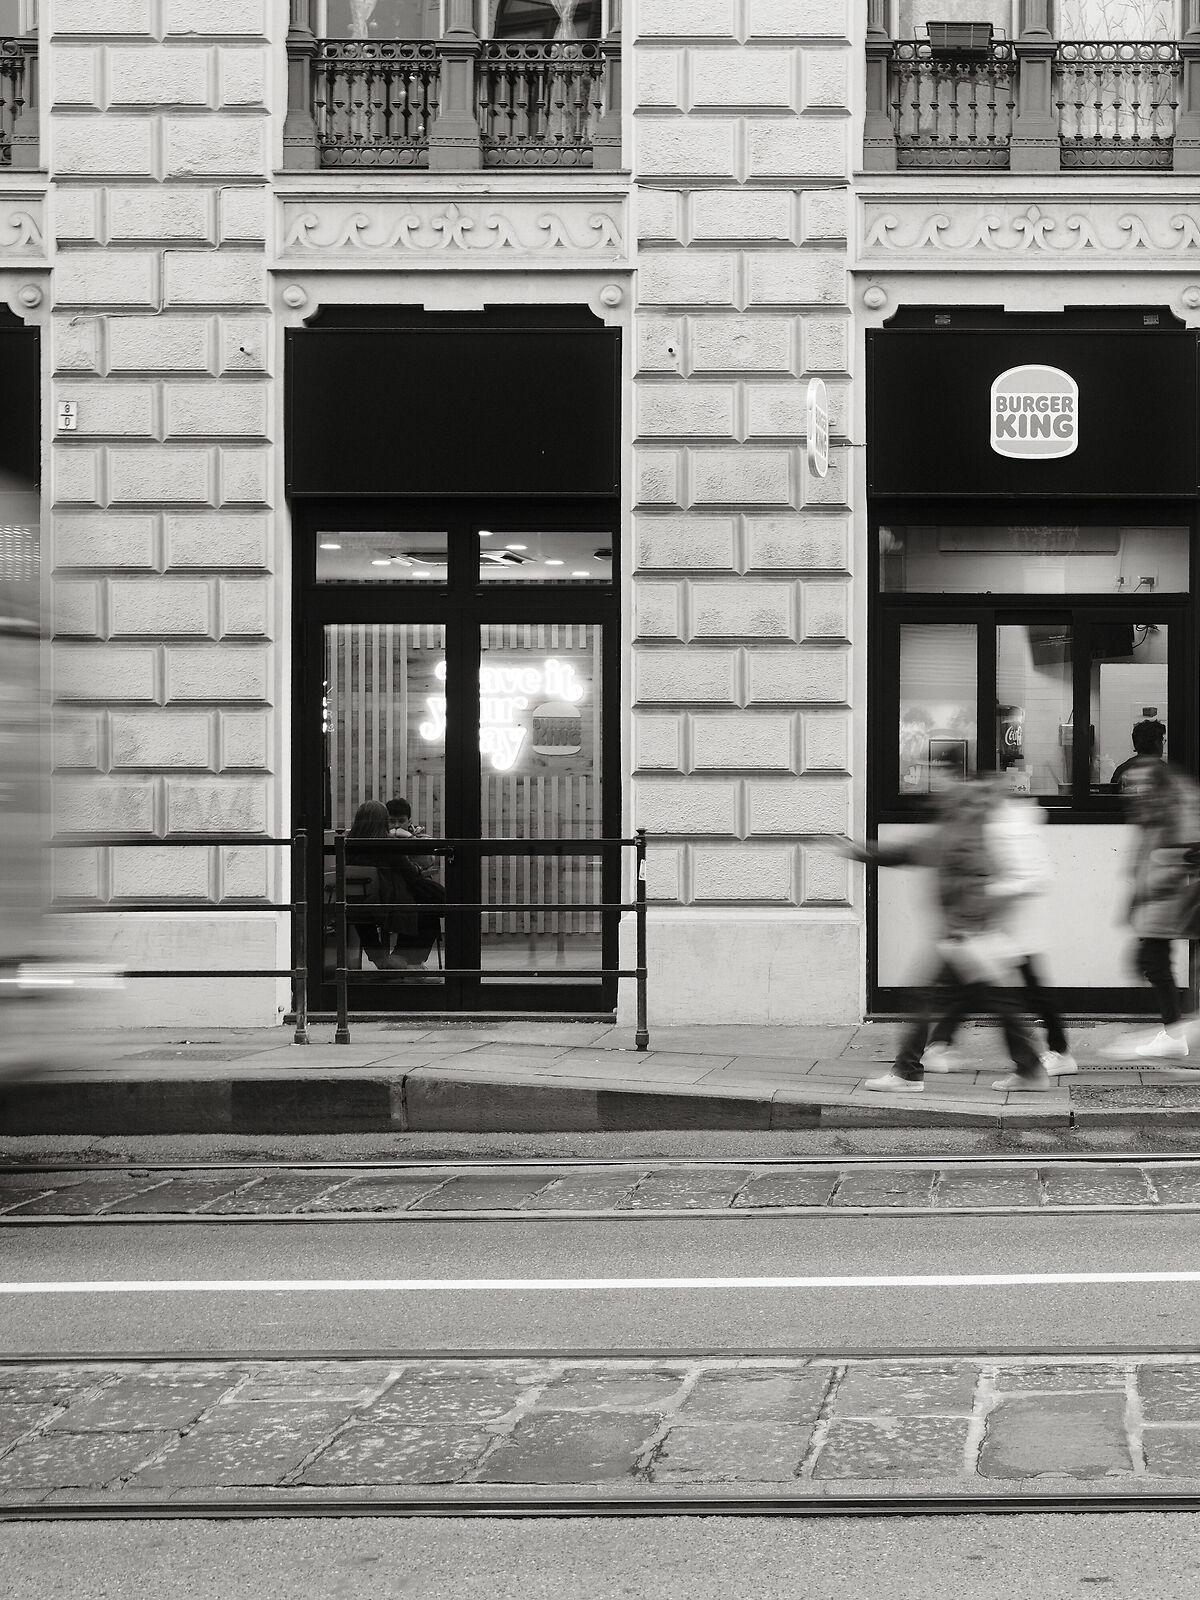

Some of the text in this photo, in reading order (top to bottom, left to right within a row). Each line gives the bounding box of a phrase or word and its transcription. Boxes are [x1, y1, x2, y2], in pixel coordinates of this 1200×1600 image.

[996, 395, 1074, 413] BURGER
[996, 413, 1074, 439] KING
[420, 696, 529, 740] yur
